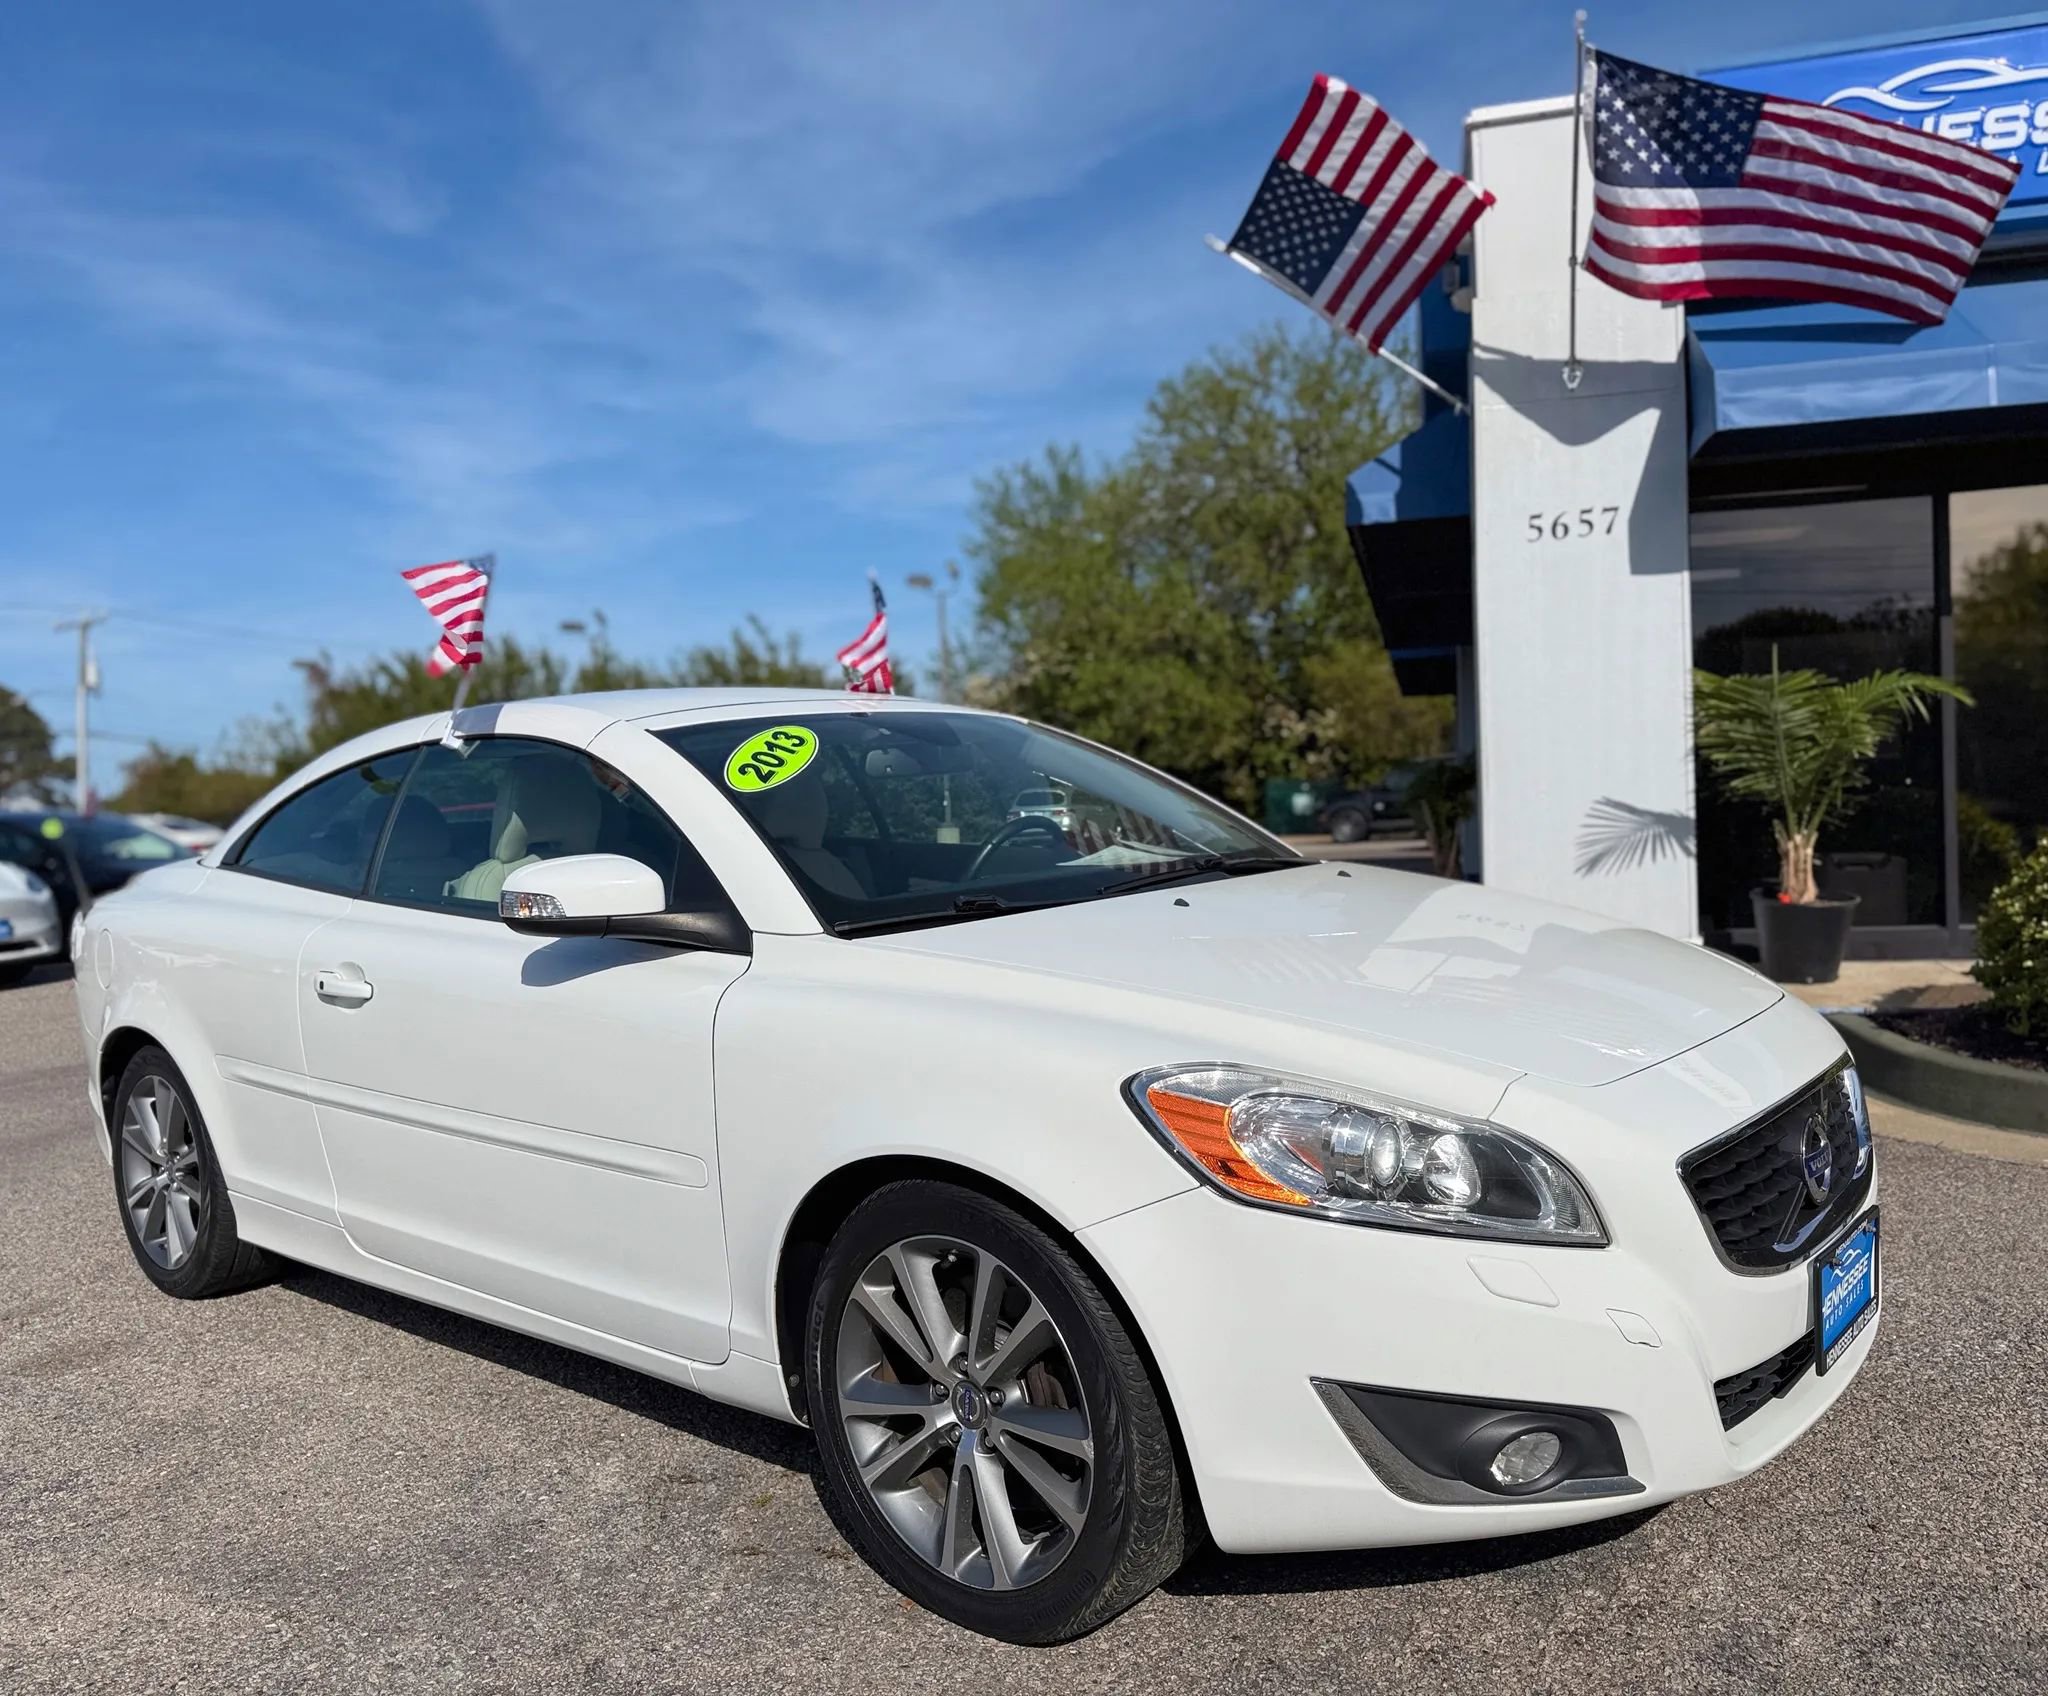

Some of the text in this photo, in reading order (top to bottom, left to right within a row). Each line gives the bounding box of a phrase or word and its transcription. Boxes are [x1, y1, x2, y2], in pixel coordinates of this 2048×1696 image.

[1526, 505, 1620, 543] 5657
[737, 730, 807, 784] 2013
[1825, 1280, 1864, 1331] AUTO SALES
